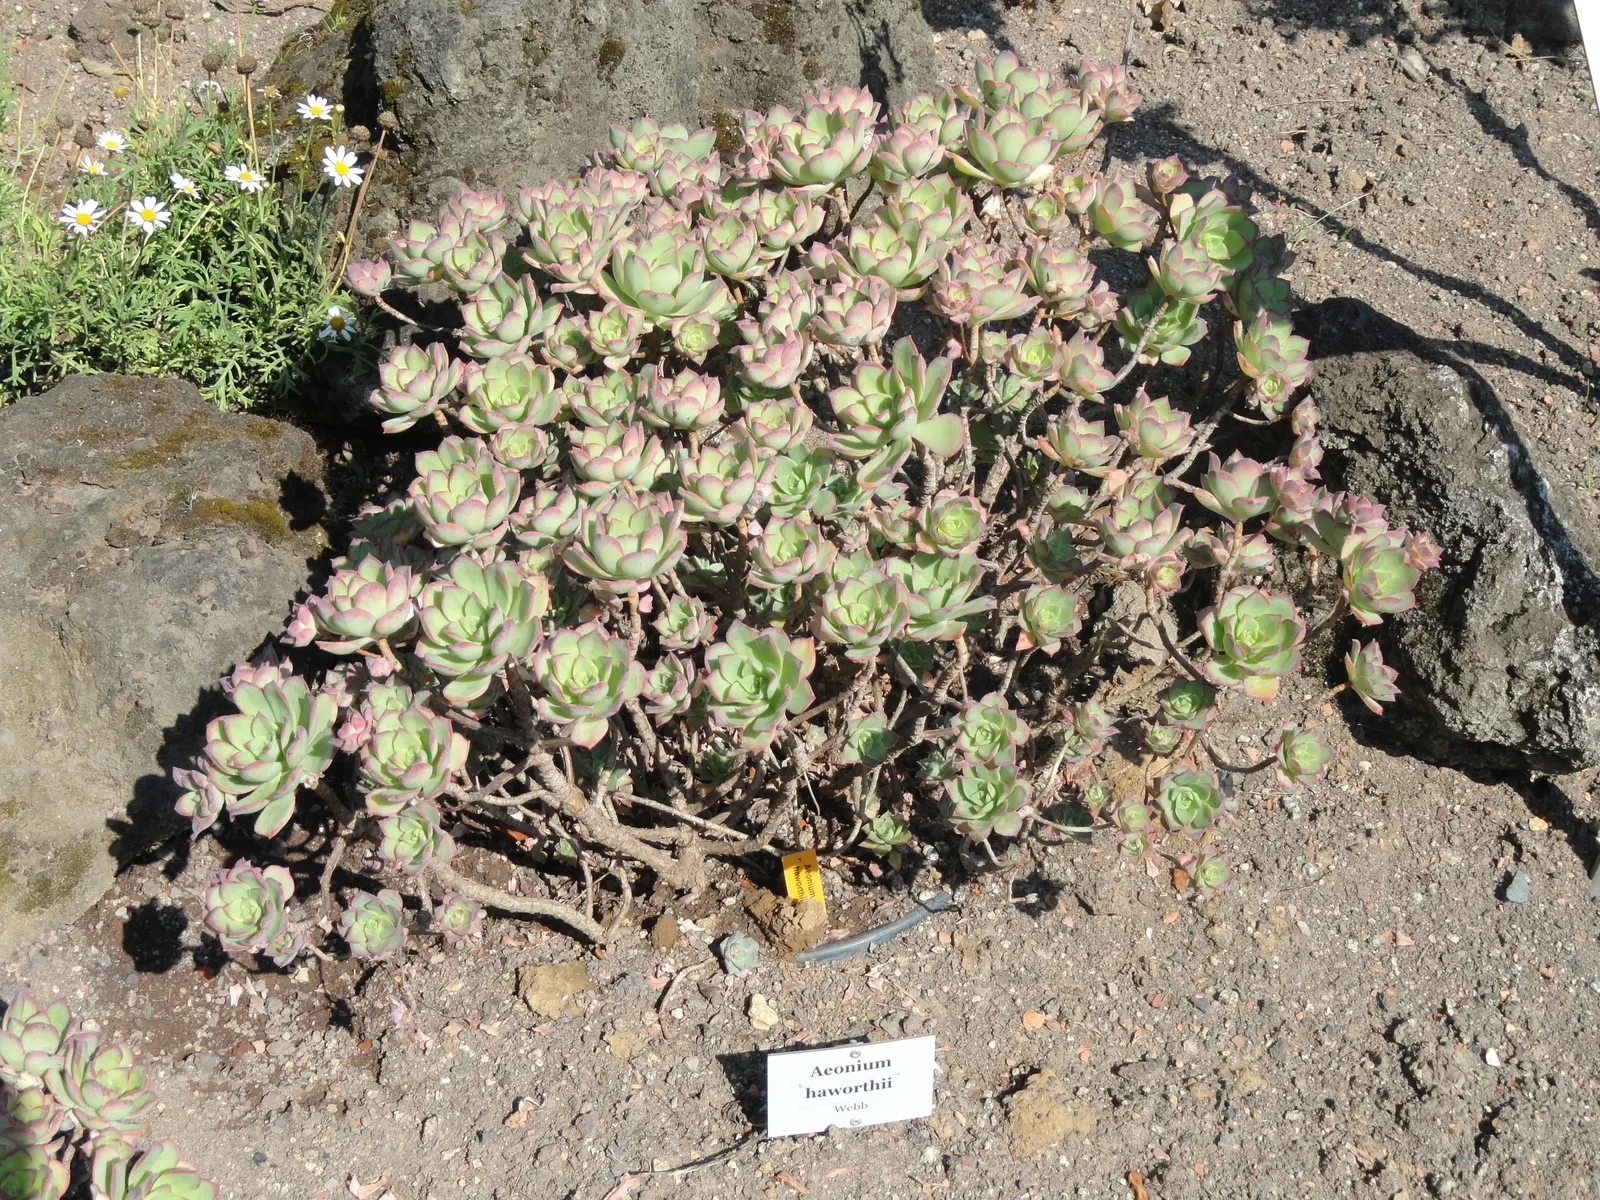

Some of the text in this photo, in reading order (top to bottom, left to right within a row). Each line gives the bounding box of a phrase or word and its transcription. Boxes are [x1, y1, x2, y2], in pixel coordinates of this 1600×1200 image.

[804, 864, 816, 897] Aeonium
[810, 1058, 892, 1077] Aeonium
[805, 1077, 893, 1099] haworthii
[834, 1102, 868, 1113] Webb
